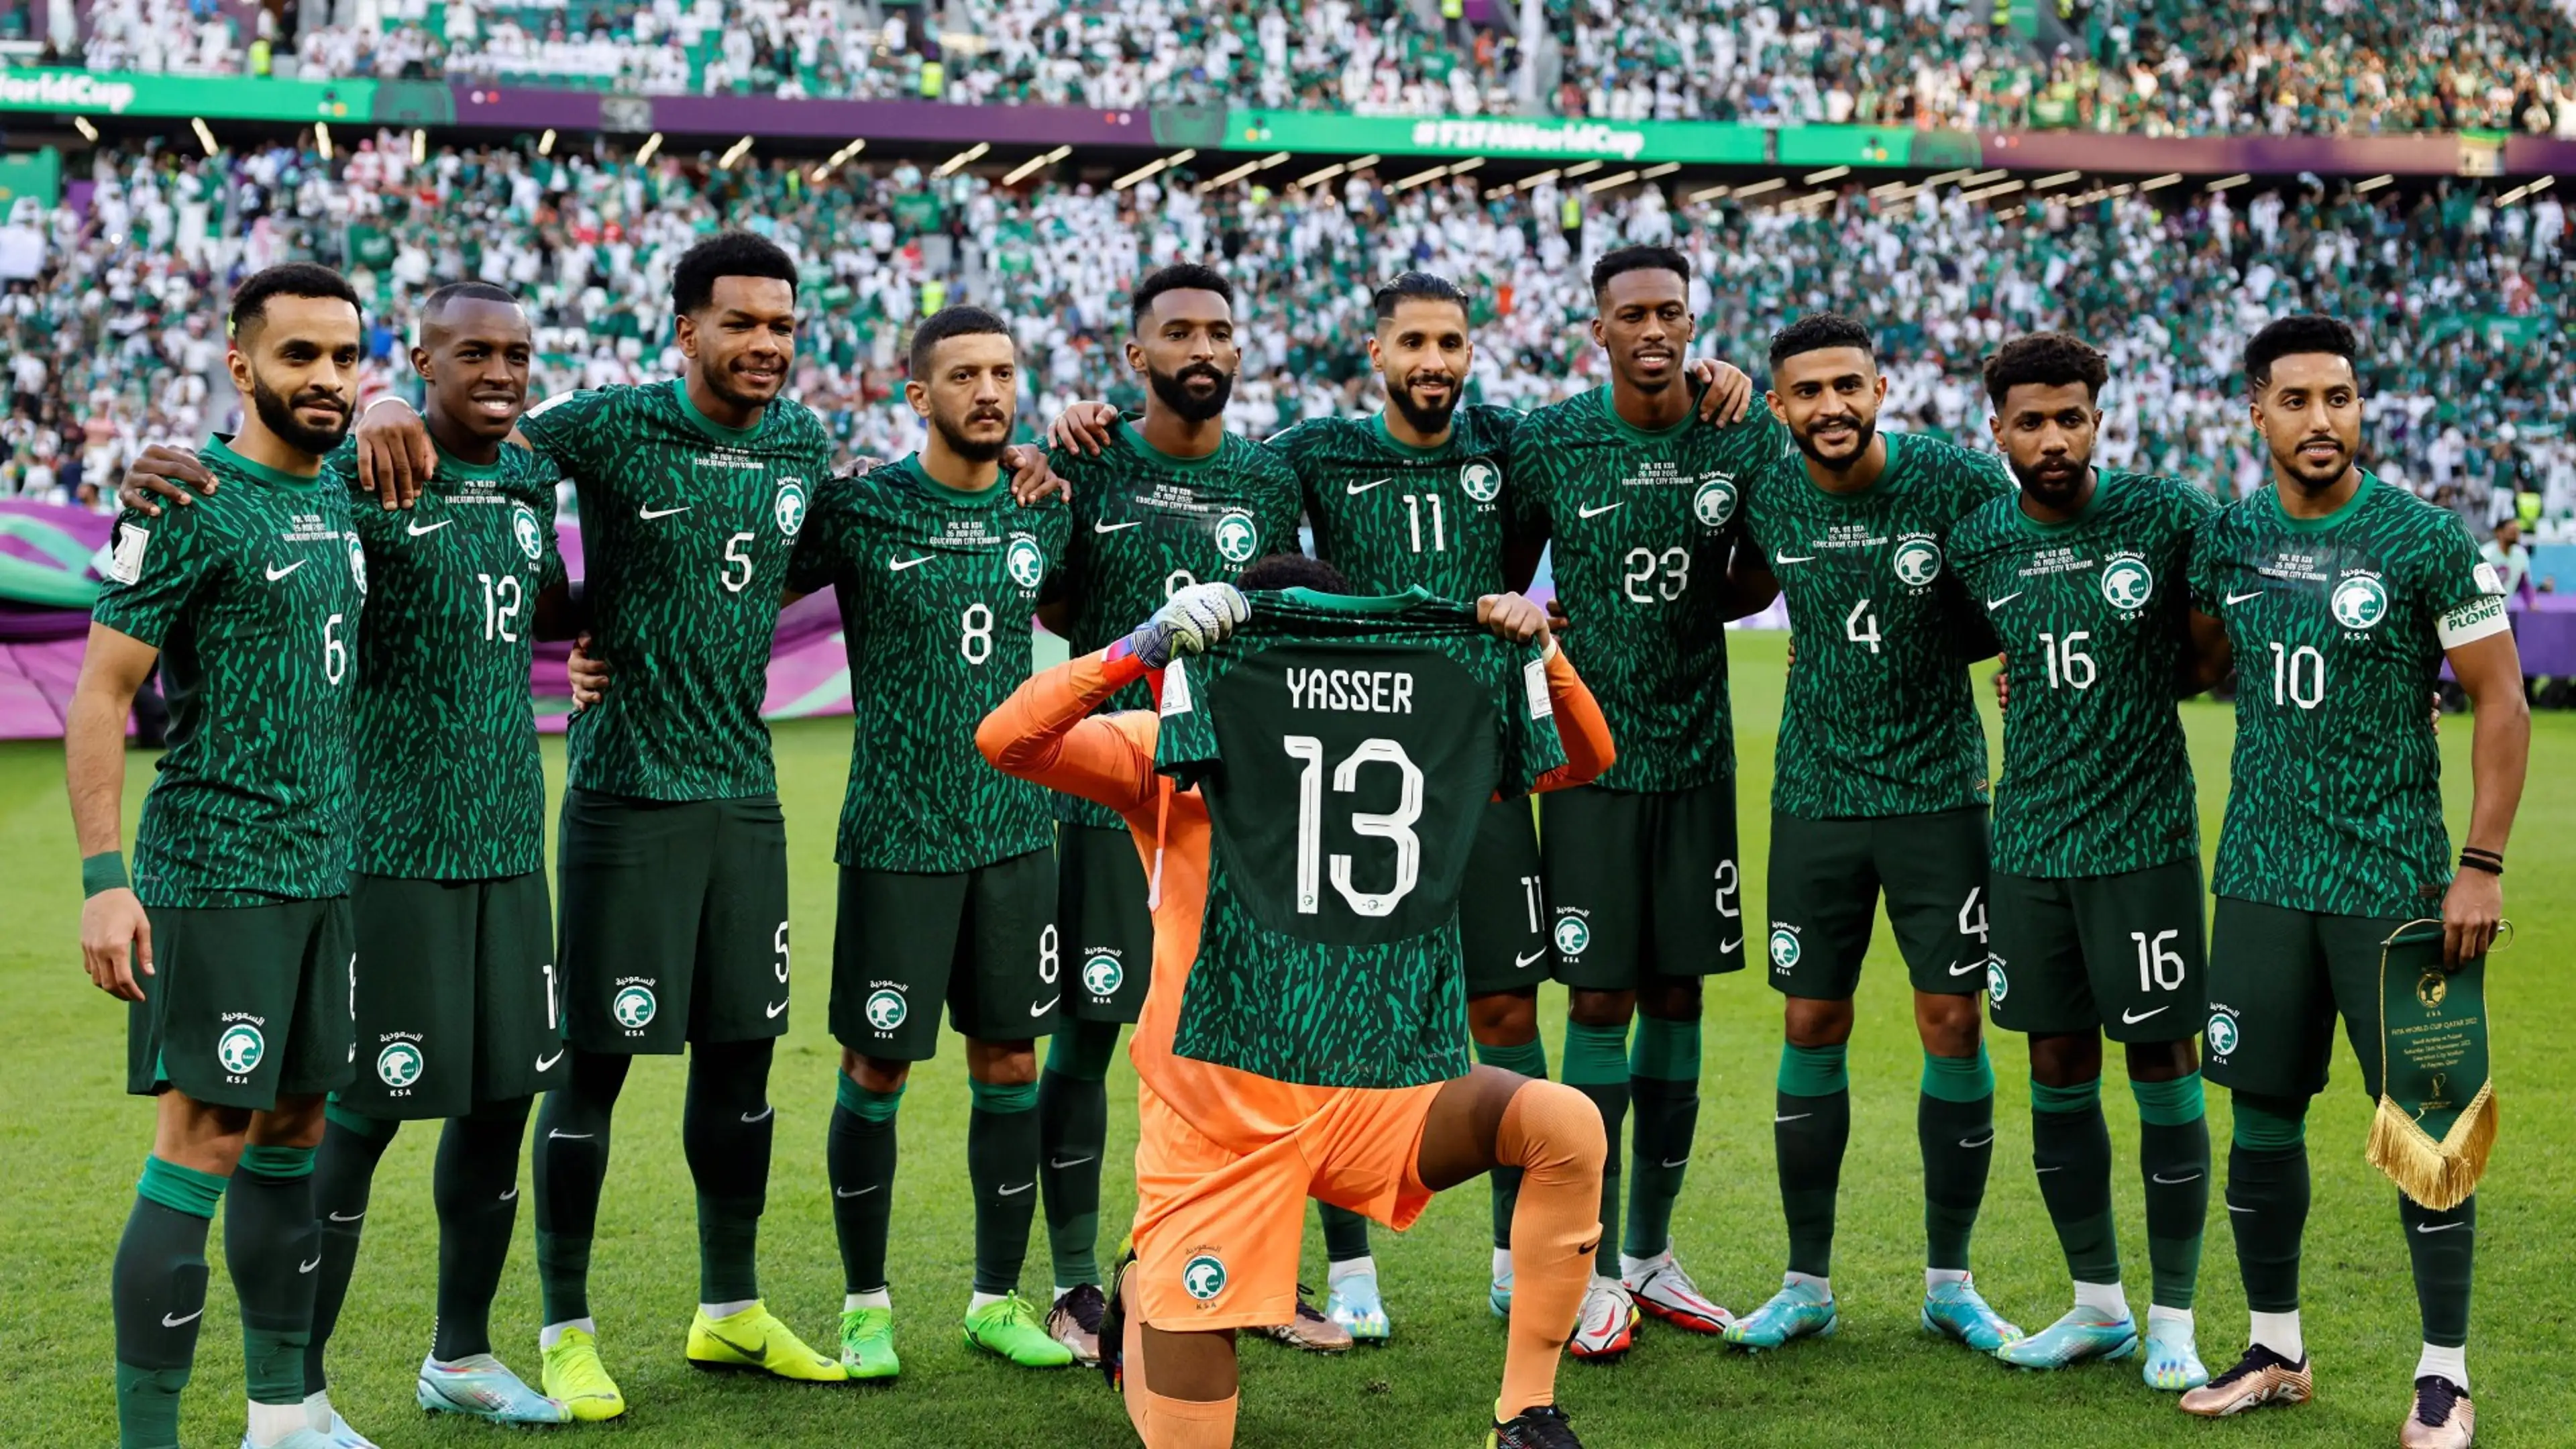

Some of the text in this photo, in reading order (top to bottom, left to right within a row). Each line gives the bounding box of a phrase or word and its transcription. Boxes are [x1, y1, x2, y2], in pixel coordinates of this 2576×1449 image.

[0, 72, 136, 114] orldCup
[1412, 120, 1645, 160] #FIFAWorldCup
[1403, 493, 1444, 552] 11
[1477, 504, 1496, 512] KSA
[721, 532, 755, 592] 5
[1624, 547, 1690, 603] 23
[478, 574, 521, 642] 12
[1909, 587, 1933, 596] KSA
[2120, 610, 2145, 621] KSA
[2446, 595, 2499, 619] SAVE THE
[2448, 604, 2502, 631] PLANET
[323, 614, 345, 685] 6
[961, 603, 993, 665] 8
[1846, 599, 1881, 653] 4
[2344, 631, 2371, 641] KSA
[2039, 631, 2096, 689] 16
[2269, 642, 2324, 709] 10
[1286, 668, 1413, 714] YASSER
[1284, 735, 1424, 917] 13
[1715, 859, 1739, 917] 2
[1958, 886, 1989, 944] 4
[775, 920, 790, 983] 5
[1039, 923, 1059, 984] 8
[2131, 929, 2185, 992] 16
[543, 964, 559, 1030] 1
[1092, 996, 1112, 1004] KSA
[874, 1031, 894, 1039] KSA
[2444, 1020, 2464, 1029] QATAR
[226, 1075, 248, 1085] KSA
[390, 1089, 411, 1097] KSA
[1196, 1301, 1216, 1309] KSA
